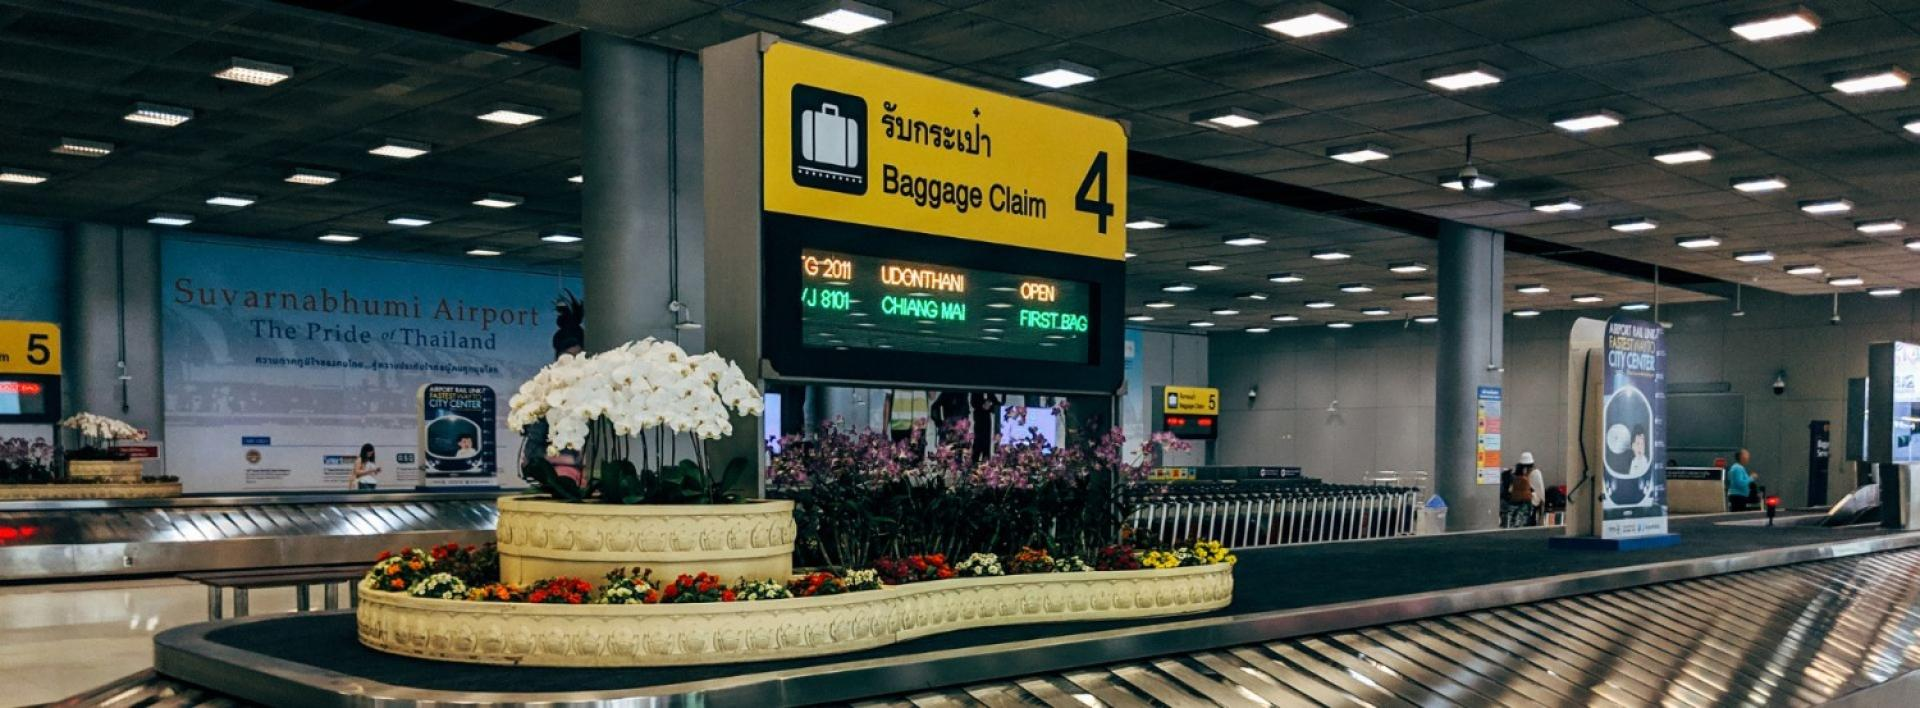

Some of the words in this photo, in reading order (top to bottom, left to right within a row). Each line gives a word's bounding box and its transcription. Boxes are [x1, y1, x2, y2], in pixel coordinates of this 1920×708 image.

[881, 100, 992, 158] รับกระเป๋า
[882, 163, 983, 214] Baggage
[988, 183, 1047, 219] Claim
[1074, 150, 1115, 235] 4
[801, 255, 819, 276] G
[822, 259, 852, 281] 2011
[880, 265, 965, 293] UDONTHANI
[1020, 282, 1056, 302] OPEN
[174, 277, 421, 319] Suvarnabhumi
[433, 297, 540, 331] Airport
[821, 289, 850, 310] 8101
[881, 295, 938, 320] CHIANG
[940, 301, 966, 321] MAI
[1019, 309, 1060, 329] FIRST
[1060, 313, 1089, 332] BAG
[27, 333, 51, 366] 5
[250, 318, 298, 340] The
[307, 322, 372, 345] Pride
[380, 328, 397, 341] of
[400, 327, 497, 350] Thailand
[1608, 350, 1626, 370] CITY
[1626, 351, 1656, 372] CENTER
[429, 400, 448, 408] CITY
[449, 400, 482, 408] CENTER
[1209, 394, 1216, 410] 5
